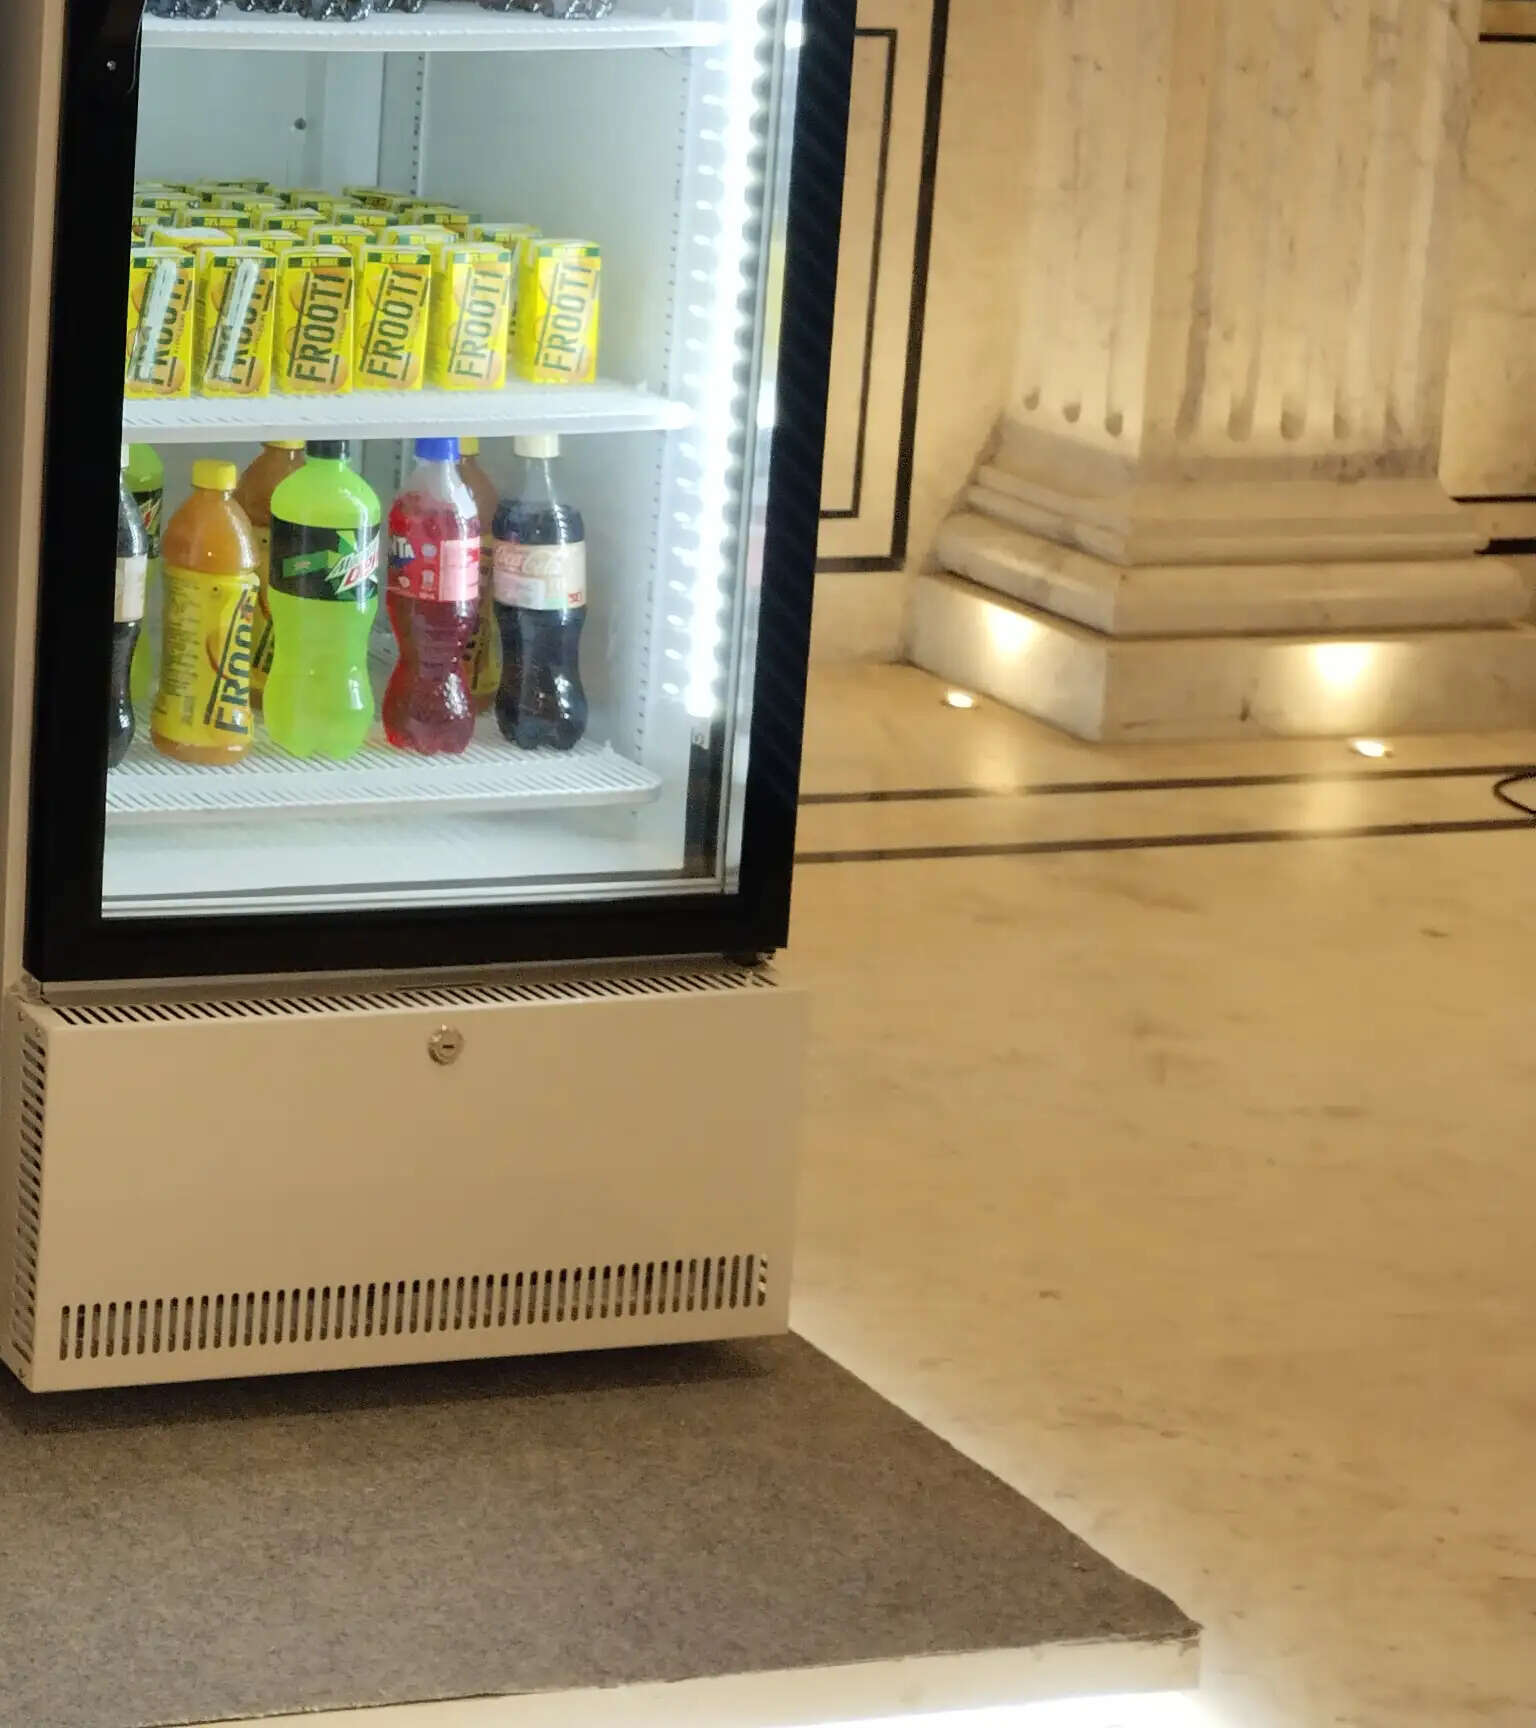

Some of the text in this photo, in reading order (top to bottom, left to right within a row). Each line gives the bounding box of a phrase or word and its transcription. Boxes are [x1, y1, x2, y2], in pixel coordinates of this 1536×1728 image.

[295, 274, 345, 383] FROOTI
[367, 269, 422, 379] FROOTI
[454, 269, 504, 378] FROOTI
[542, 263, 592, 372] FROOTI
